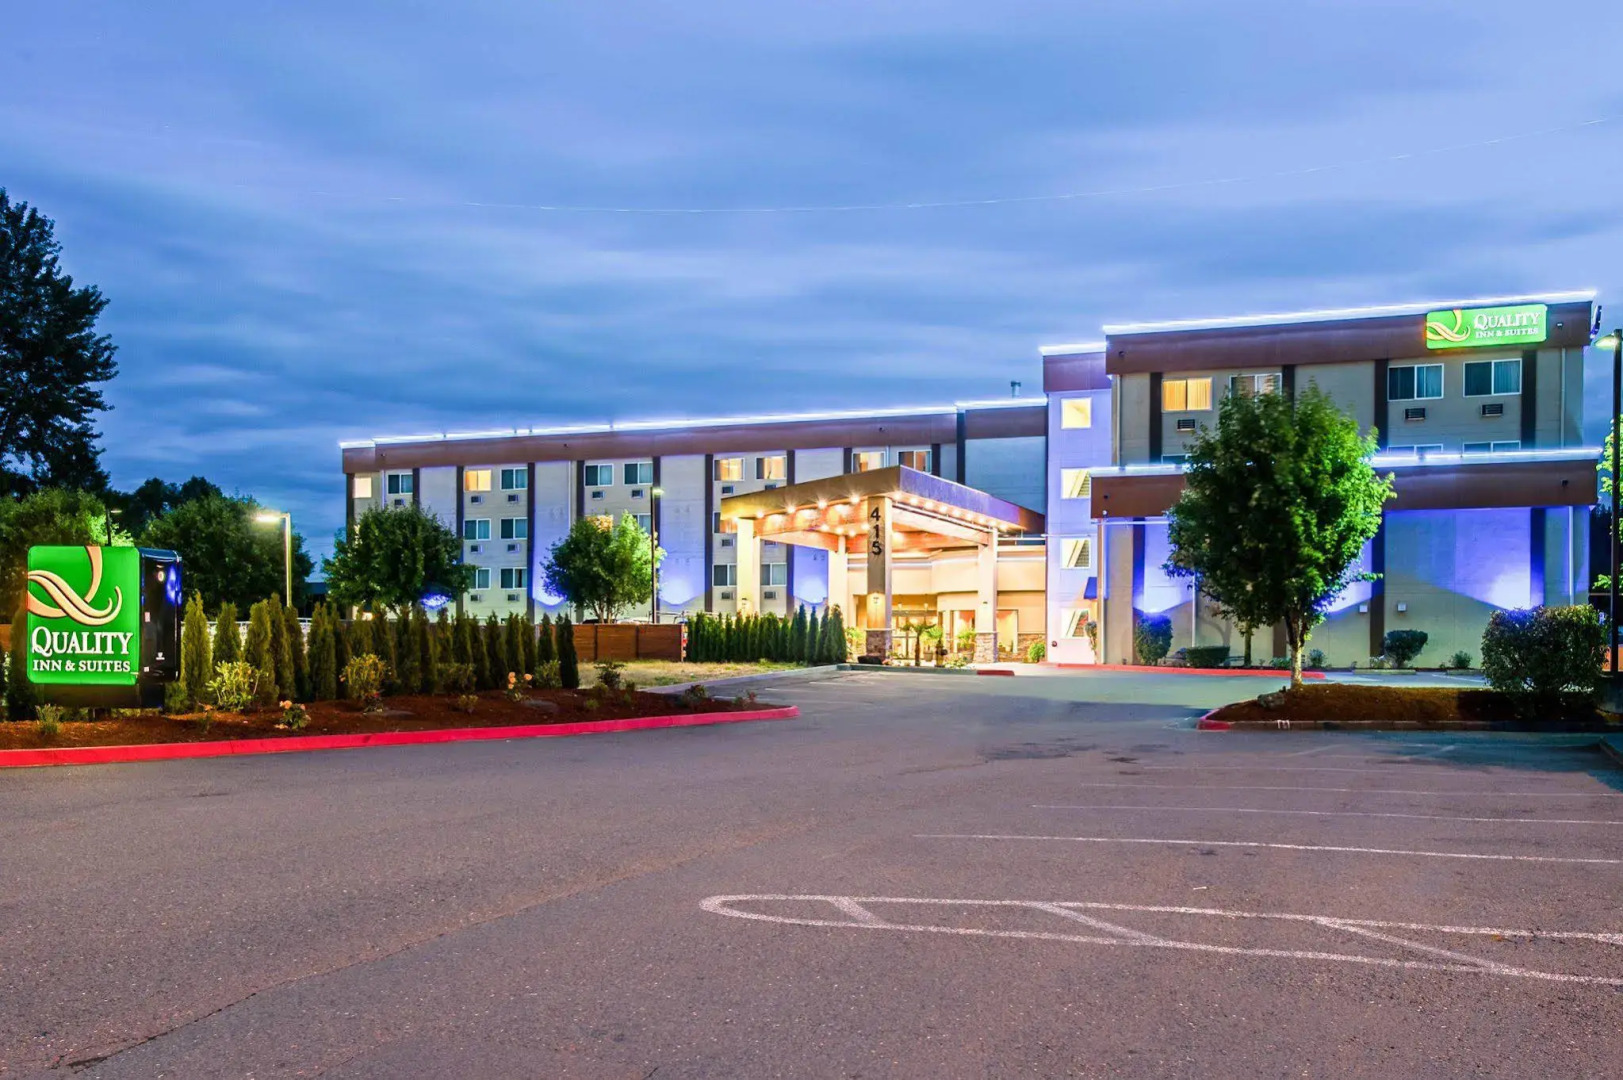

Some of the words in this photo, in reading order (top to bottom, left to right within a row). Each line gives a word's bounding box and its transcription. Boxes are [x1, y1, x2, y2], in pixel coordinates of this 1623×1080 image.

[1474, 313, 1540, 330] QUALITY
[1475, 330, 1494, 338] INN
[1504, 327, 1539, 336] SUITES
[871, 507, 882, 556] 415
[31, 626, 133, 657] QUALITY
[33, 660, 62, 672] INN
[65, 660, 75, 672] &
[78, 660, 131, 672] SUITES
